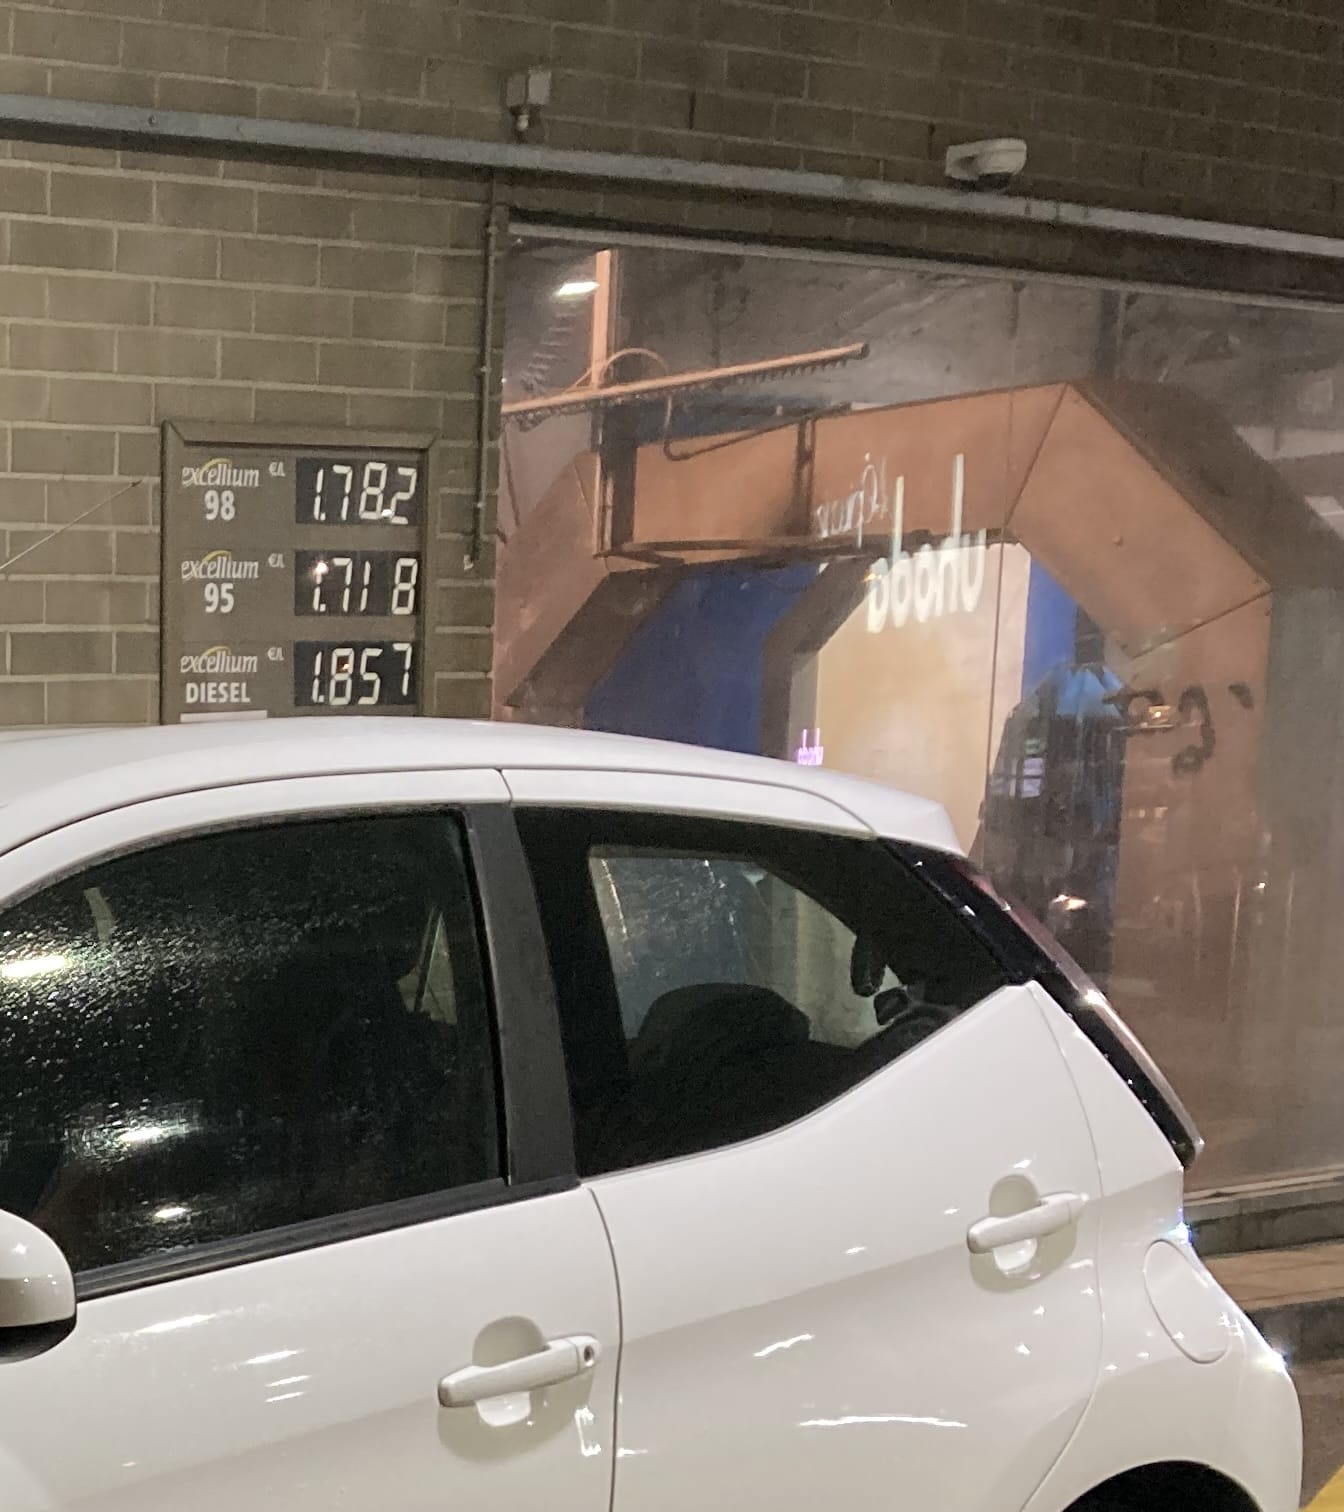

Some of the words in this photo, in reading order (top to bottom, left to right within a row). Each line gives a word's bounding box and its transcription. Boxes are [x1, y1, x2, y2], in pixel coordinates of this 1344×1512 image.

[182, 464, 260, 487] excellium
[204, 490, 236, 521] 98
[181, 555, 259, 579] excellium
[204, 583, 234, 613] 95
[312, 557, 418, 615] 1.718
[180, 650, 258, 674] excellium
[312, 643, 412, 706] 1.857
[185, 682, 252, 703] DIESEL
